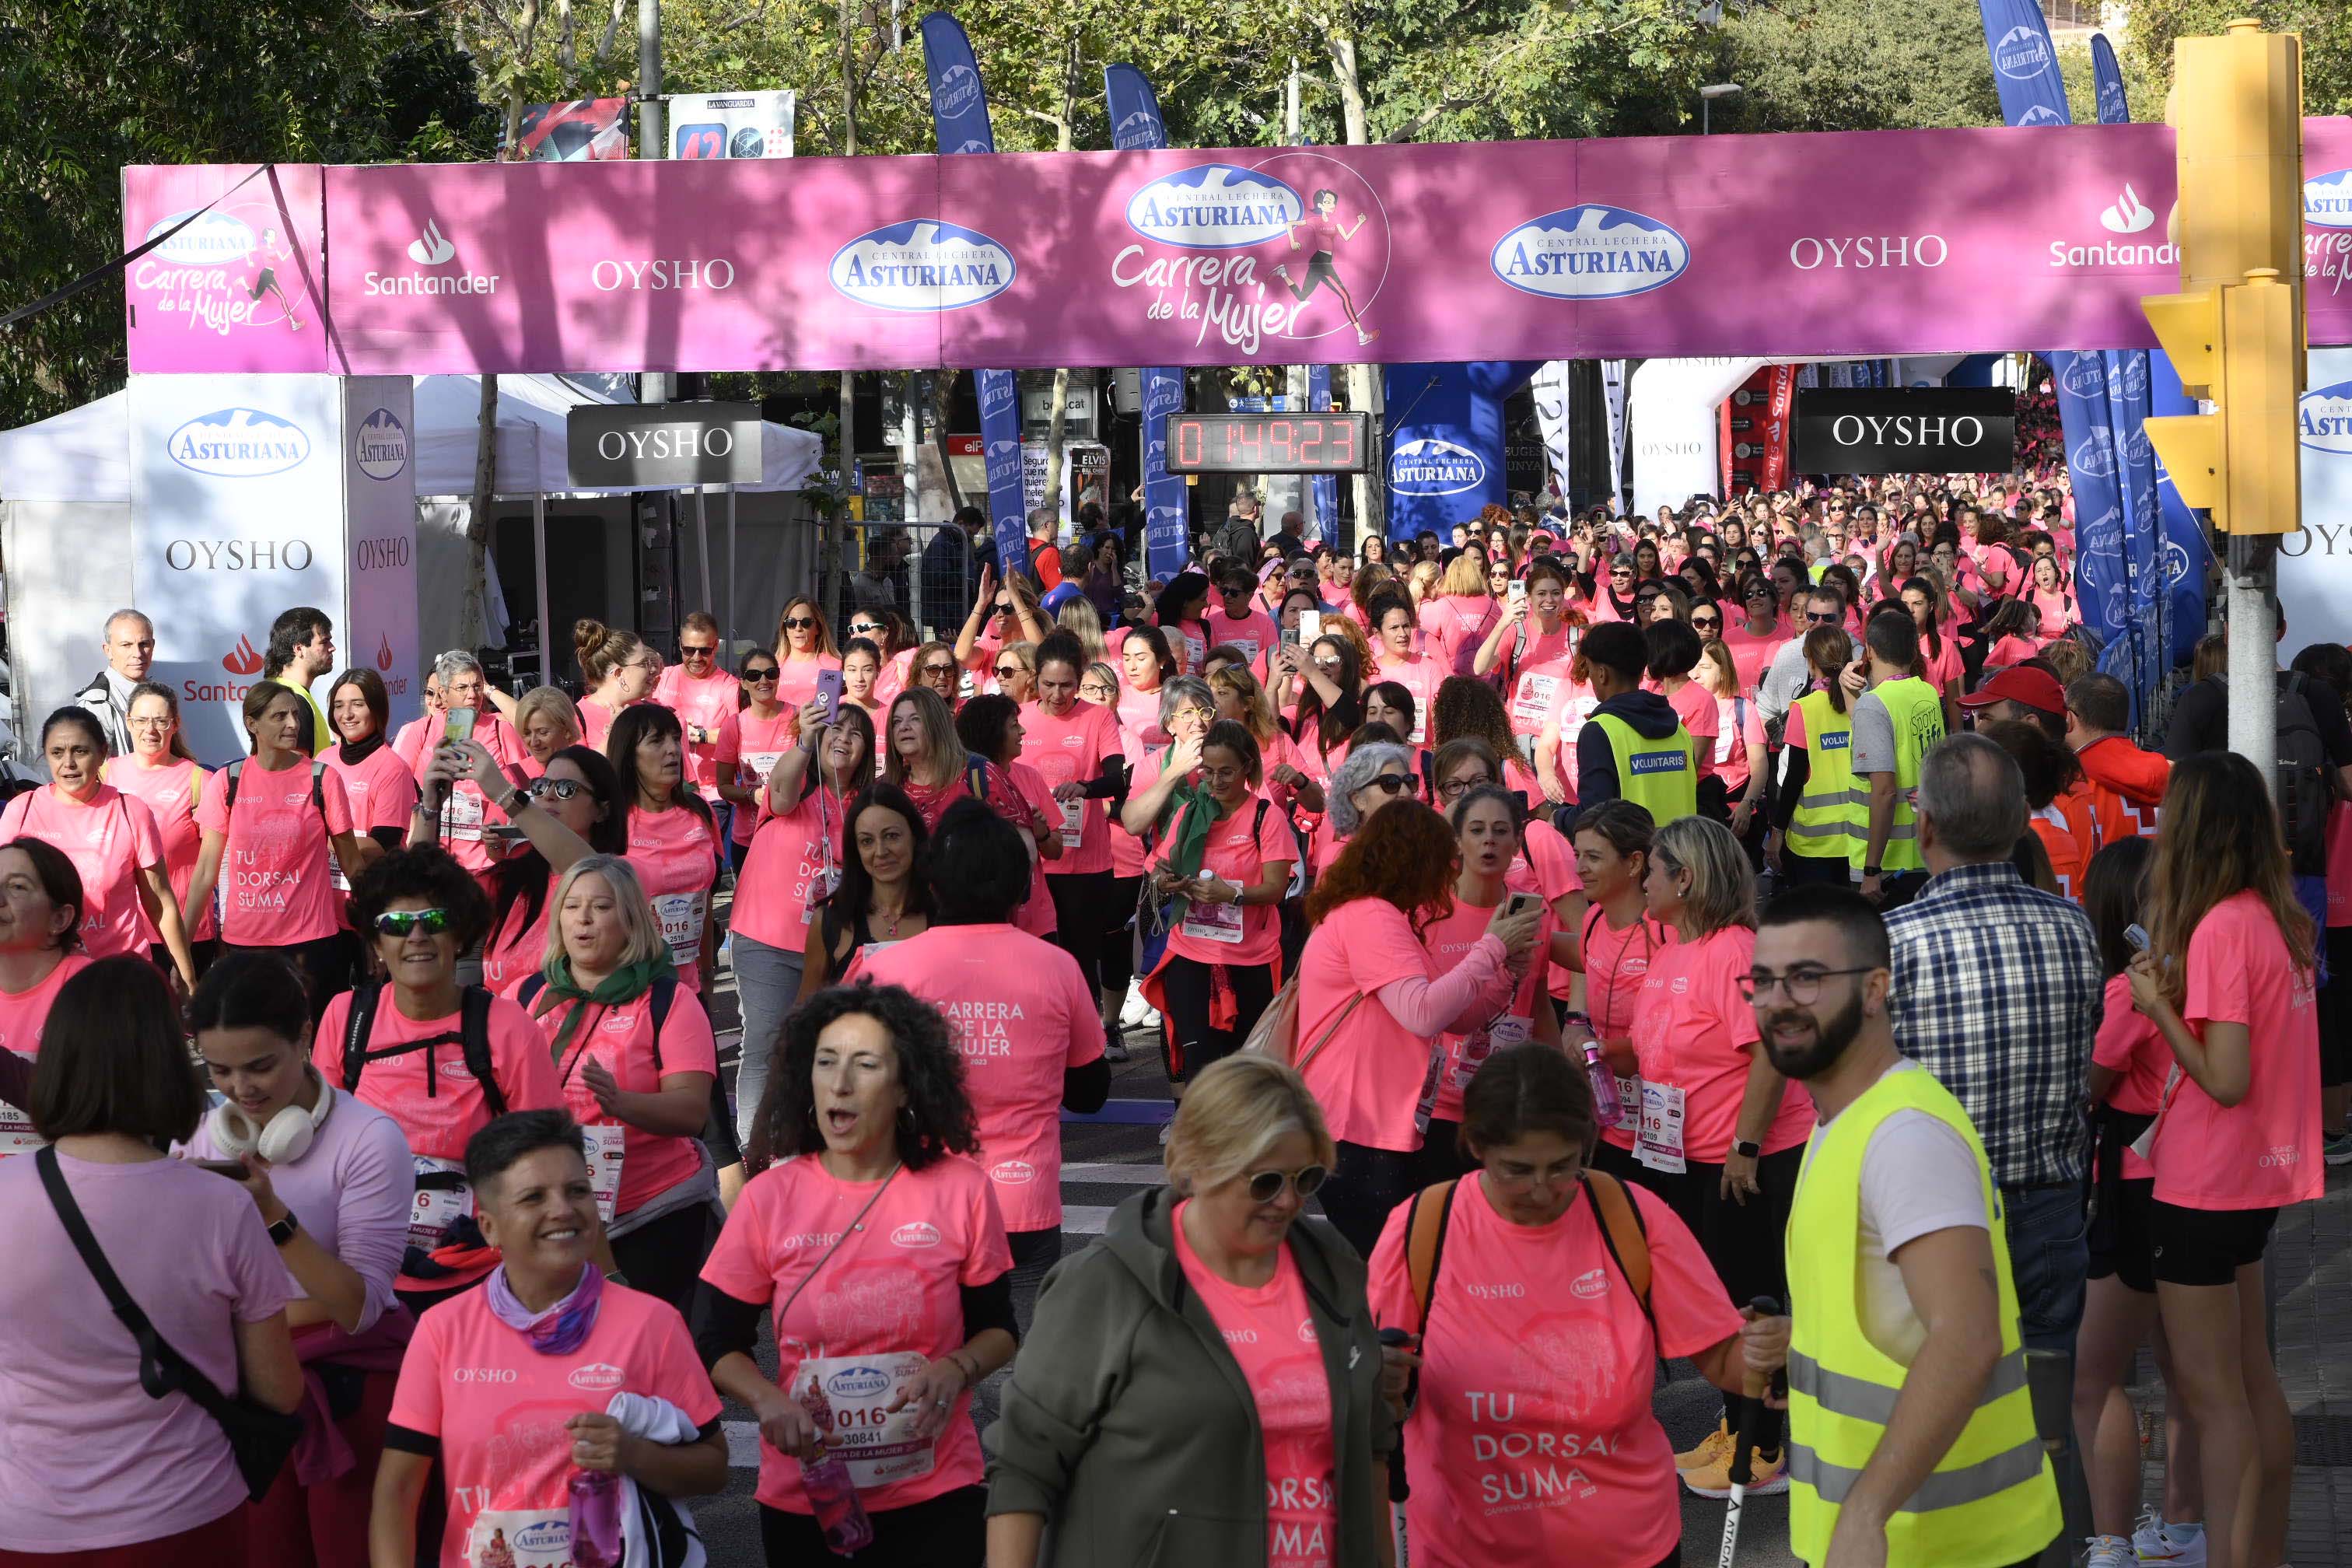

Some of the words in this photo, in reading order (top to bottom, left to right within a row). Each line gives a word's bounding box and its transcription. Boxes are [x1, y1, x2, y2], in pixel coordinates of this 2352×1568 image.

[716, 100, 754, 108] VANGUARDIA
[1139, 196, 1288, 228] ASTURIANA
[1537, 238, 1598, 247] CENTRAL
[1605, 236, 1668, 246] LECHERA
[1790, 235, 1948, 269] OYSHO
[1111, 244, 1258, 288] Carrera
[1507, 241, 1674, 276] ASTURIANA
[135, 261, 226, 290] Carrera
[592, 259, 735, 292] OYSHO
[844, 253, 1002, 287] ASTURIANA
[365, 271, 499, 296] Santander
[158, 292, 176, 313] de
[178, 289, 192, 313] la
[189, 285, 261, 335] Mujer
[1147, 289, 1173, 320] de
[1180, 289, 1199, 320] la
[1195, 282, 1312, 356] Mujer
[1832, 415, 1983, 447] OYSHO
[179, 435, 300, 460] ASTURIANA
[359, 443, 404, 464] ASTURIANA
[598, 428, 733, 460] OYSHO
[1083, 455, 1105, 464] ELVIS
[1024, 468, 1037, 478] que
[1390, 465, 1477, 484] ASTURIANA
[1025, 499, 1039, 508] este
[166, 540, 312, 571] OYSHO
[357, 536, 408, 571] OYSHO
[1912, 705, 1937, 737] Sport
[1631, 754, 1684, 772] VOLUNTARIS
[236, 850, 255, 865] TU
[804, 842, 821, 861] TU
[237, 869, 301, 887] DORSAL
[239, 891, 285, 908] SUMA
[665, 921, 688, 933] 016
[350, 1011, 363, 1052] SALOMON
[982, 1020, 1006, 1037] LA
[417, 1192, 431, 1207] 6
[1468, 1283, 1524, 1300] OYSHO
[453, 1367, 517, 1384] OYSHO
[833, 1380, 886, 1392] ASTURIANA
[838, 1406, 886, 1428] 016
[1465, 1391, 1515, 1423] TU
[845, 1430, 882, 1445] 30841
[849, 1449, 862, 1458] DE
[863, 1448, 873, 1457] LA
[875, 1445, 903, 1457] MUJER
[1481, 1462, 1591, 1504] SUMA
[1579, 1485, 1600, 1499] 2023
